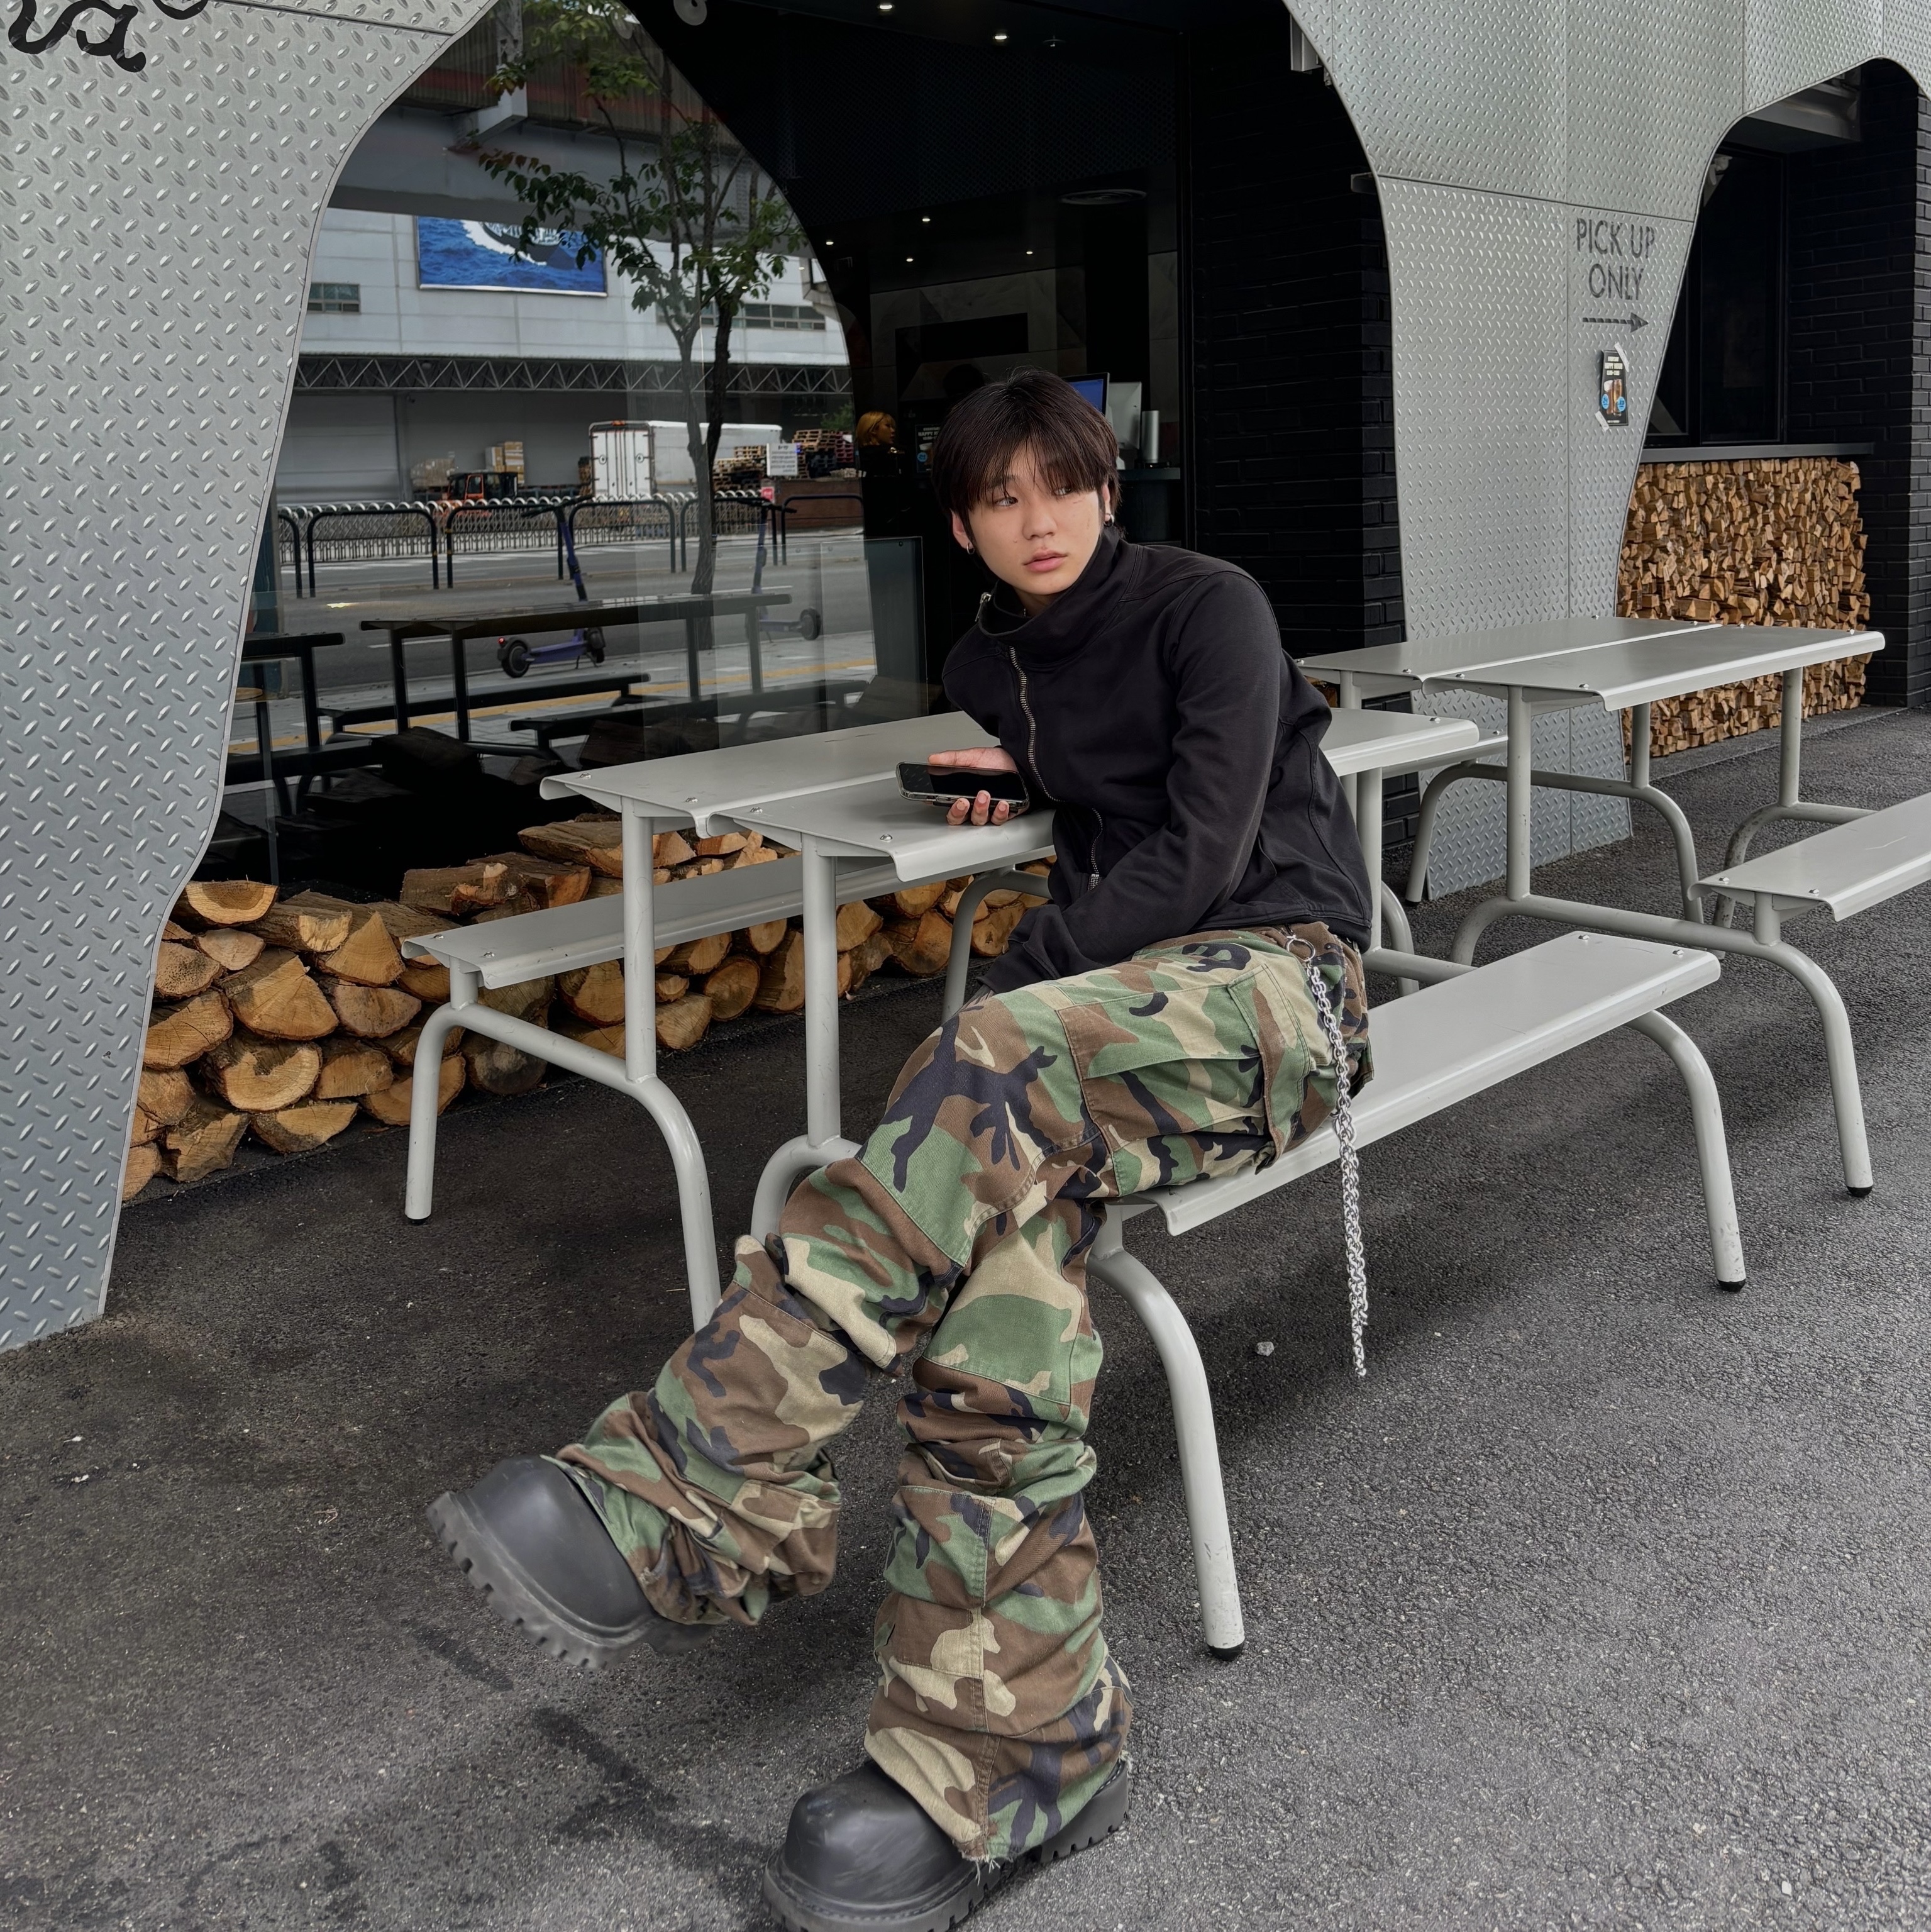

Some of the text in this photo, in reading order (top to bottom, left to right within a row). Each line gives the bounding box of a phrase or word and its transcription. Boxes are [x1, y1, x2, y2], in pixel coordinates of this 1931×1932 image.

[1576, 218, 1655, 258] PICK UP
[1589, 264, 1644, 301] ONLY
